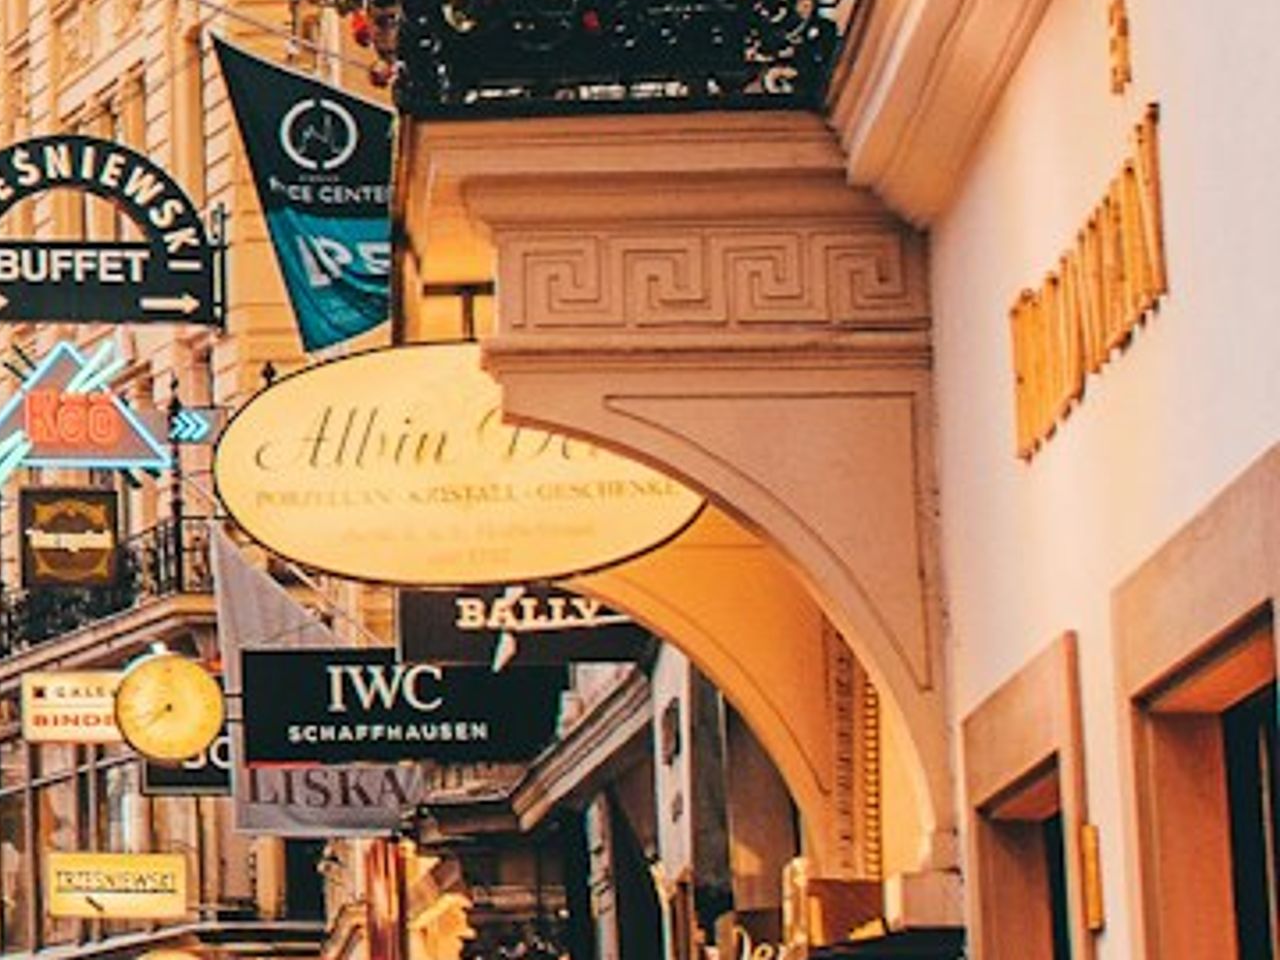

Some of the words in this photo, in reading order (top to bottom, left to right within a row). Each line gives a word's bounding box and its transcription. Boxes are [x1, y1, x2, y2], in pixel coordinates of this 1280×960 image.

[319, 184, 393, 204] CENTE
[254, 406, 449, 470] Albin
[456, 597, 603, 631] BALLY
[326, 664, 444, 713] IWC
[288, 722, 489, 743] SCHAFFHAUSEN
[247, 766, 411, 807] LISKA
